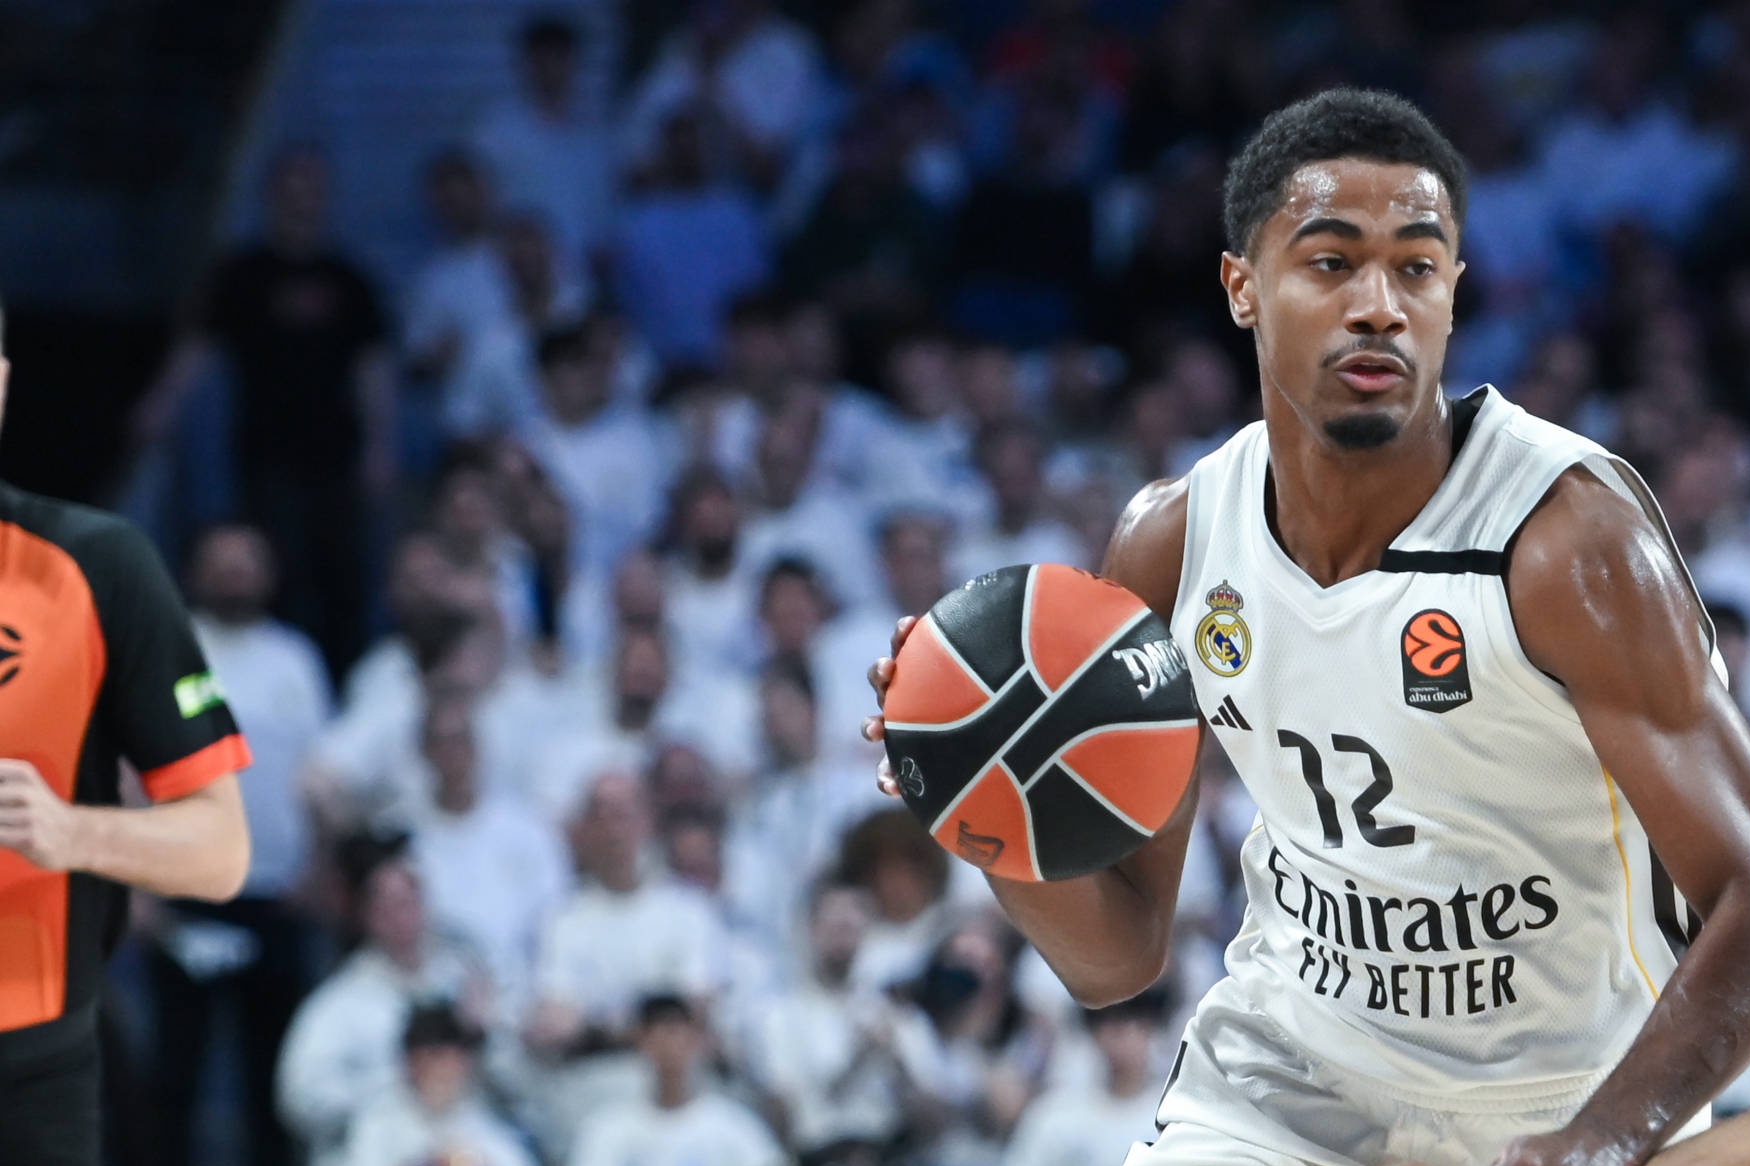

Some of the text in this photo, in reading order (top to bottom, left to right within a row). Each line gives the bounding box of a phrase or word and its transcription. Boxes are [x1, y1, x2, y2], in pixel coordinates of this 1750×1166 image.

[1408, 691, 1432, 703] abu
[1433, 690, 1468, 702] dhabi
[1268, 845, 1559, 952] Emirates
[1299, 936, 1517, 1019] FLY BETTER
